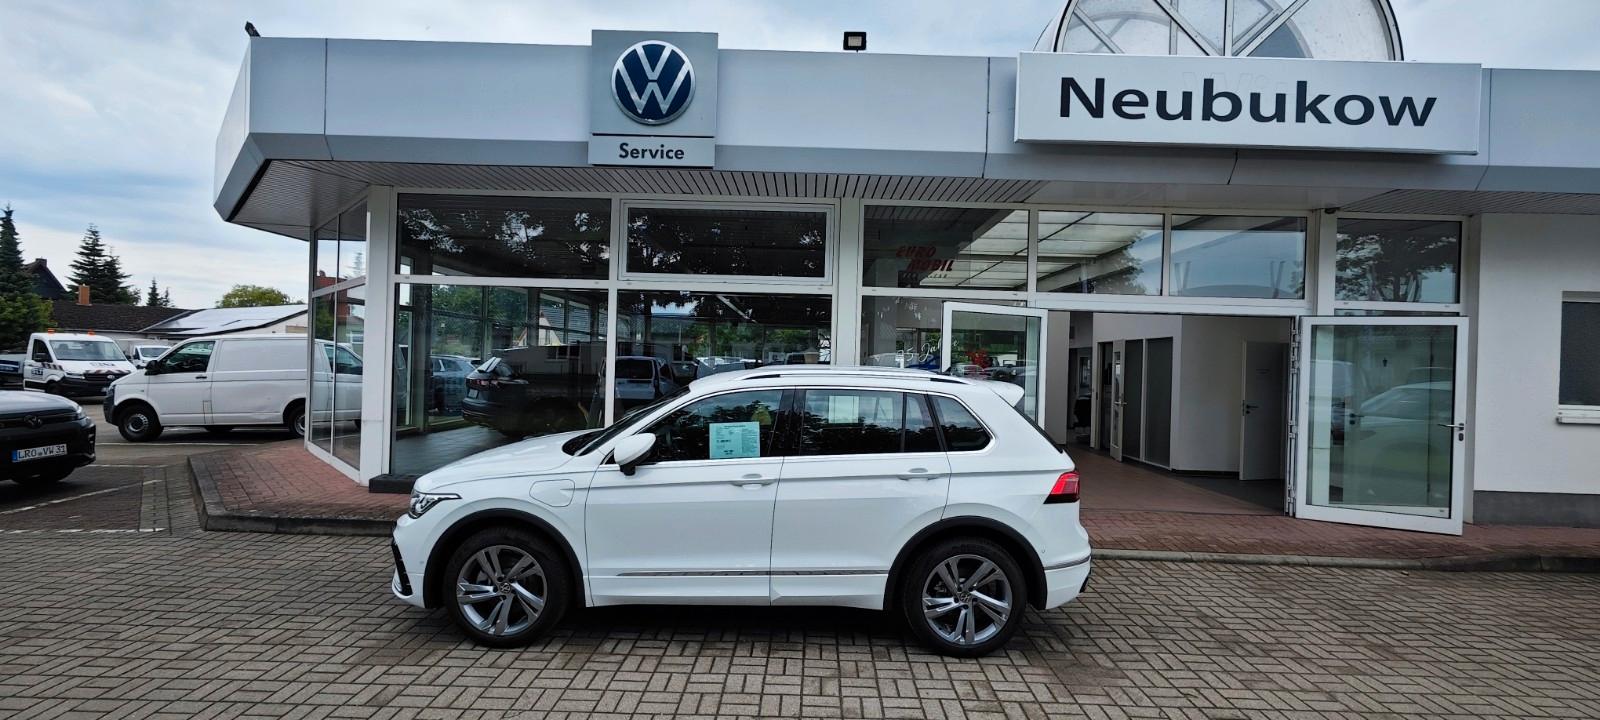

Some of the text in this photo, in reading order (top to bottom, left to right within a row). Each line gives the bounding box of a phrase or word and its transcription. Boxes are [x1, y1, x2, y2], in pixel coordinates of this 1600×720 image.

[1059, 76, 1437, 127] Neubukow
[619, 142, 685, 160] Service
[18, 445, 65, 459] LRO VW 31
